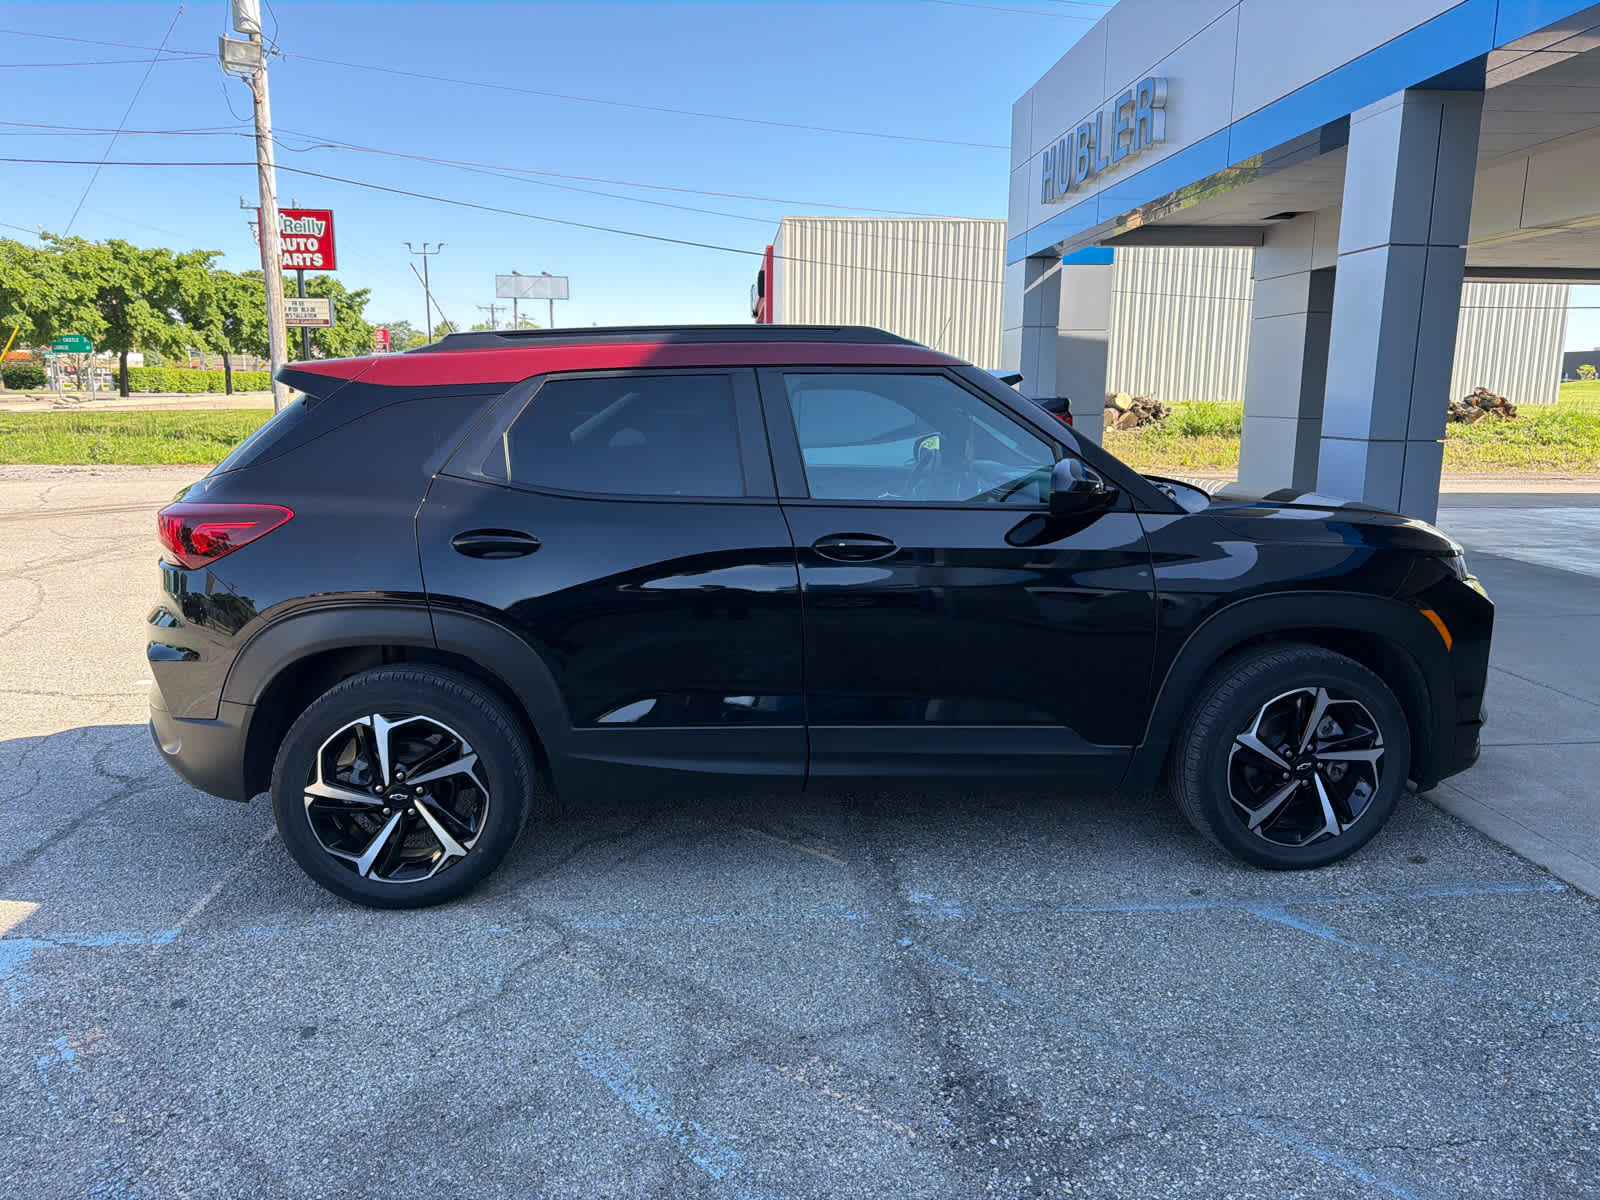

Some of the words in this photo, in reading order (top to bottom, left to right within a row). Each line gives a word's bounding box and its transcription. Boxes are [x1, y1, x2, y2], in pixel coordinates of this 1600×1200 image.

[1041, 76, 1166, 205] HUBLER
[280, 214, 325, 236] 'Reilly
[282, 253, 323, 266] ARTS
